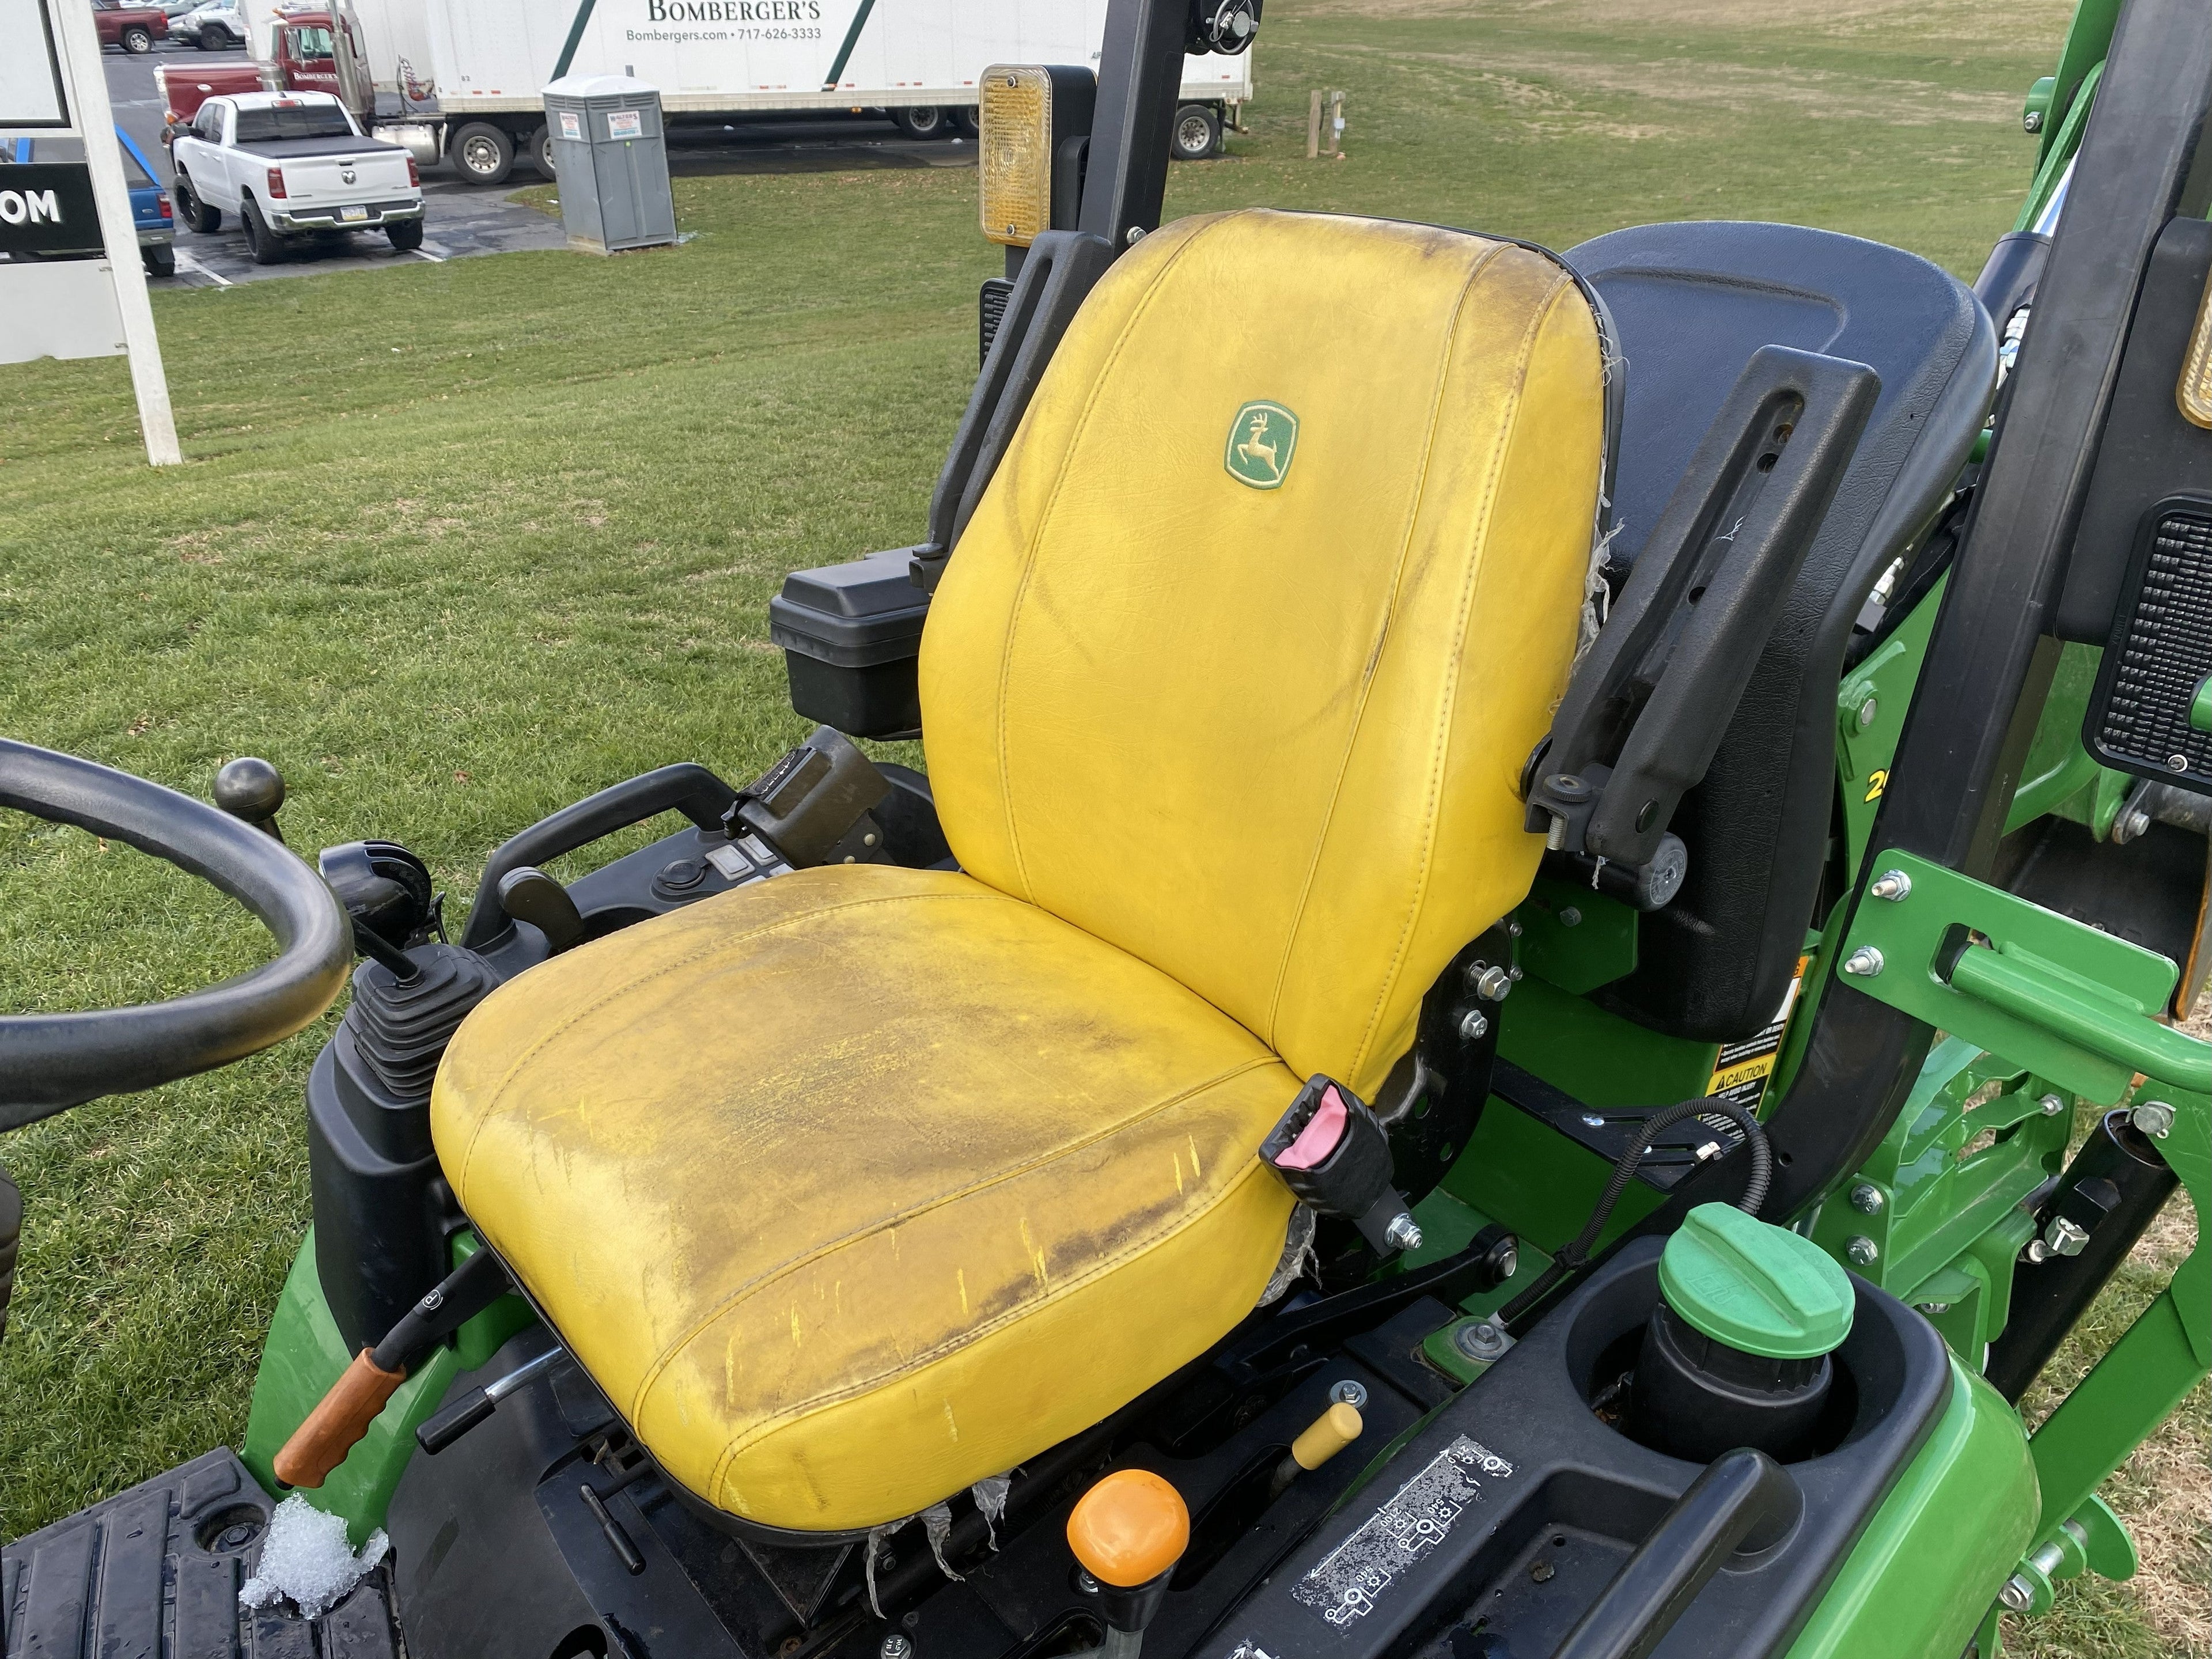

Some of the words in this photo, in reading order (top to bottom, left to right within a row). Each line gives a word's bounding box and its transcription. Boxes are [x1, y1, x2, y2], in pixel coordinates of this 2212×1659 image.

[626, 29, 728, 43] Bombergers.com
[738, 28, 821, 40] 717-626-3333
[1725, 1063, 1768, 1087] CAUTION
[1427, 1498, 1445, 1514] 540
[1380, 1507, 1402, 1527] 2100
[1355, 1565, 1374, 1582] 540
